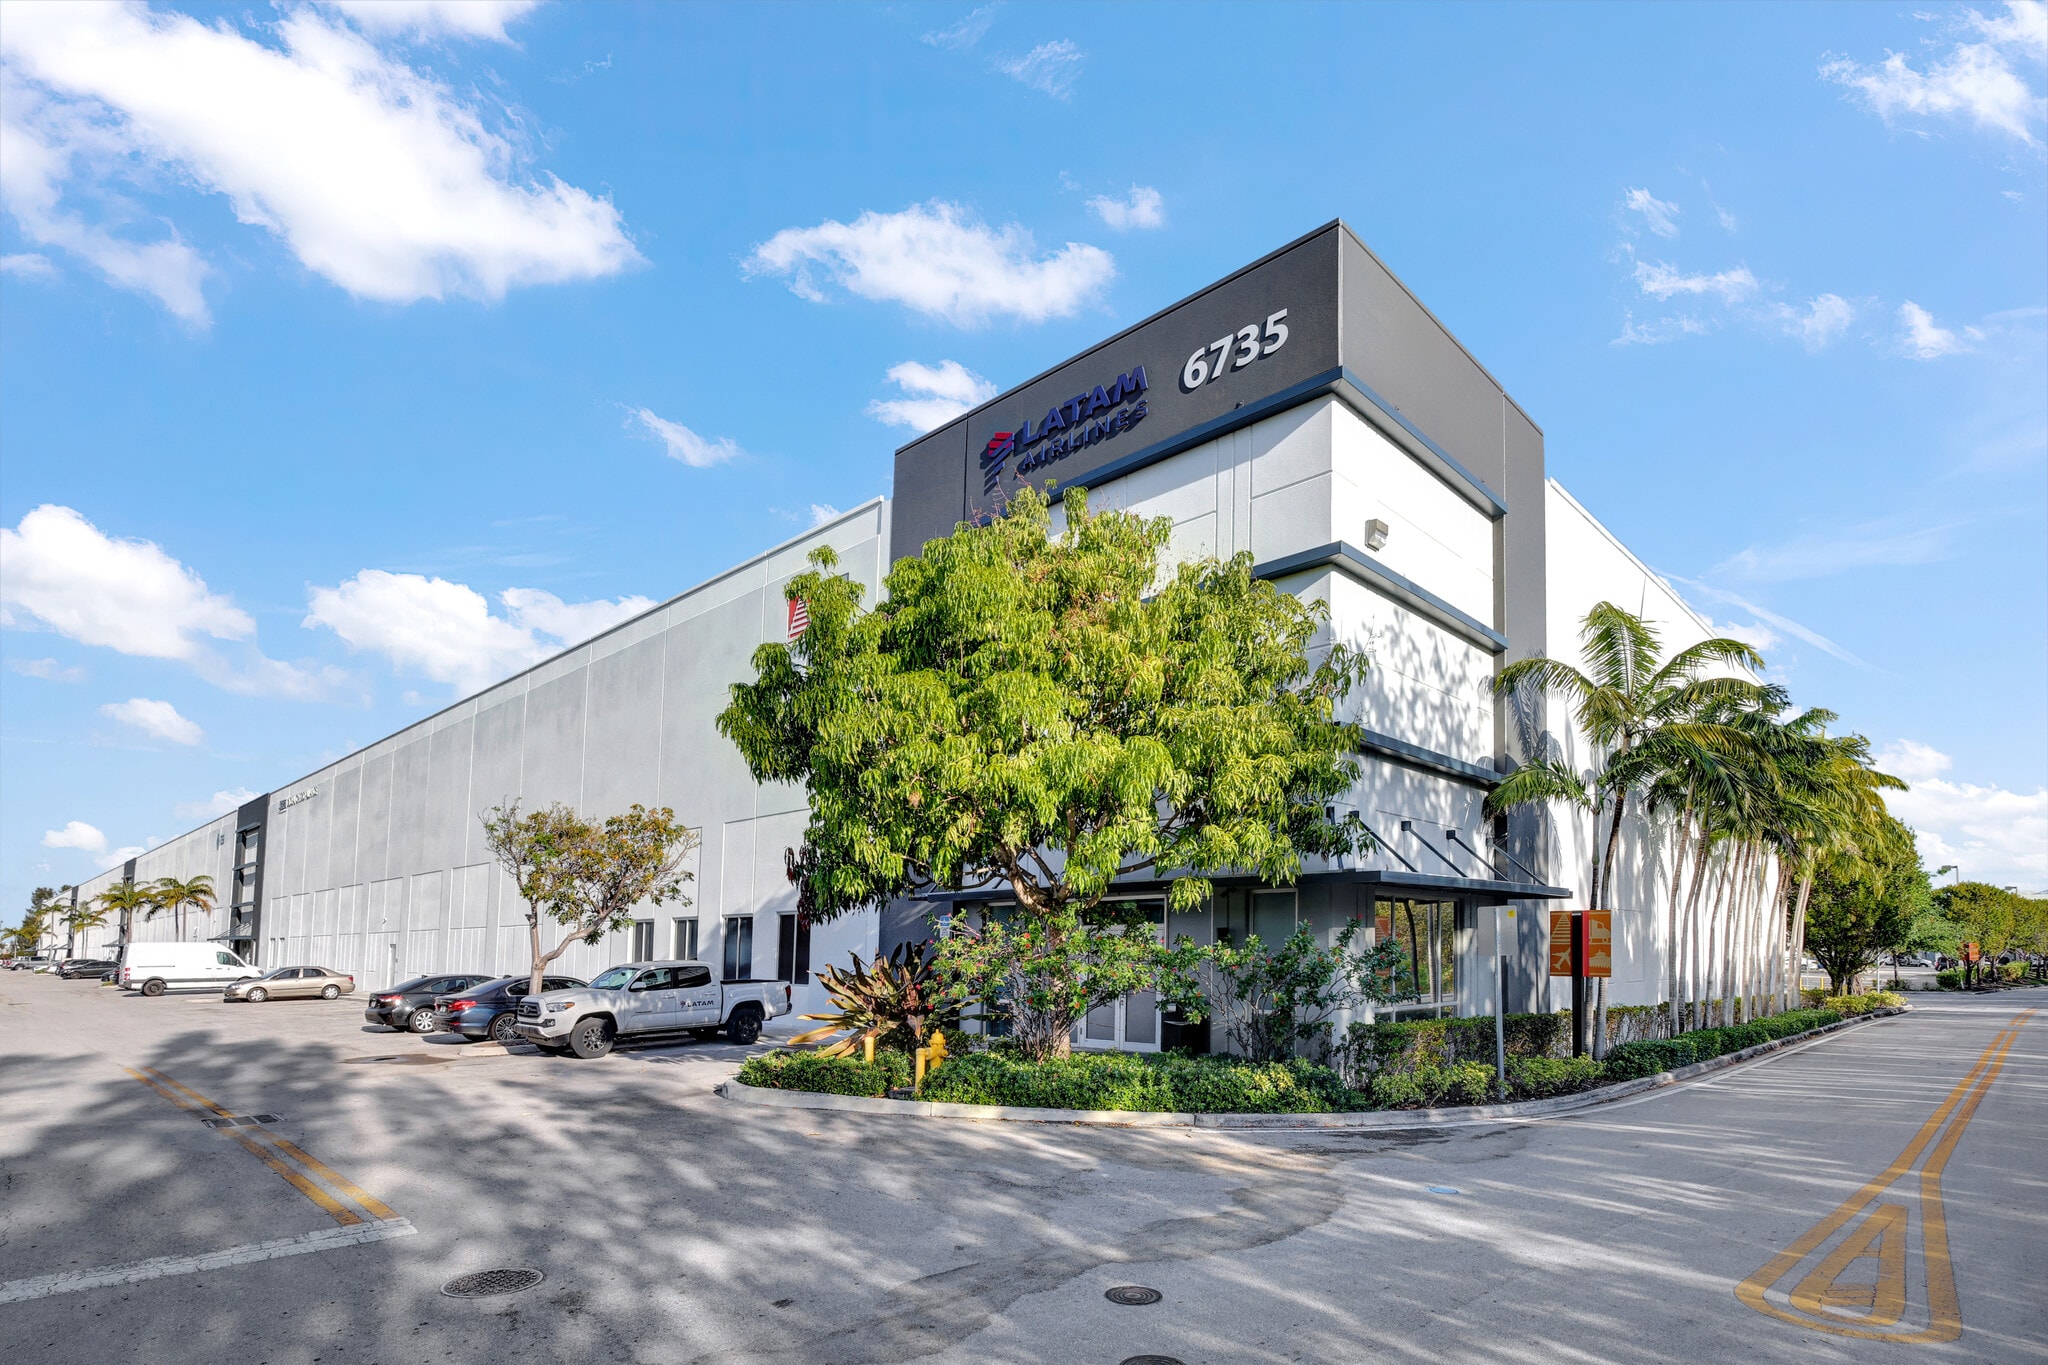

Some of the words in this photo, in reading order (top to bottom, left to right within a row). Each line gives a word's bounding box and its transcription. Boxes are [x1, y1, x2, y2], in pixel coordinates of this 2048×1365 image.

[1183, 308, 1289, 389] 6735
[1022, 365, 1149, 445] LATAM
[1022, 399, 1149, 470] AIRLINES
[687, 1000, 715, 1008] LATAM
